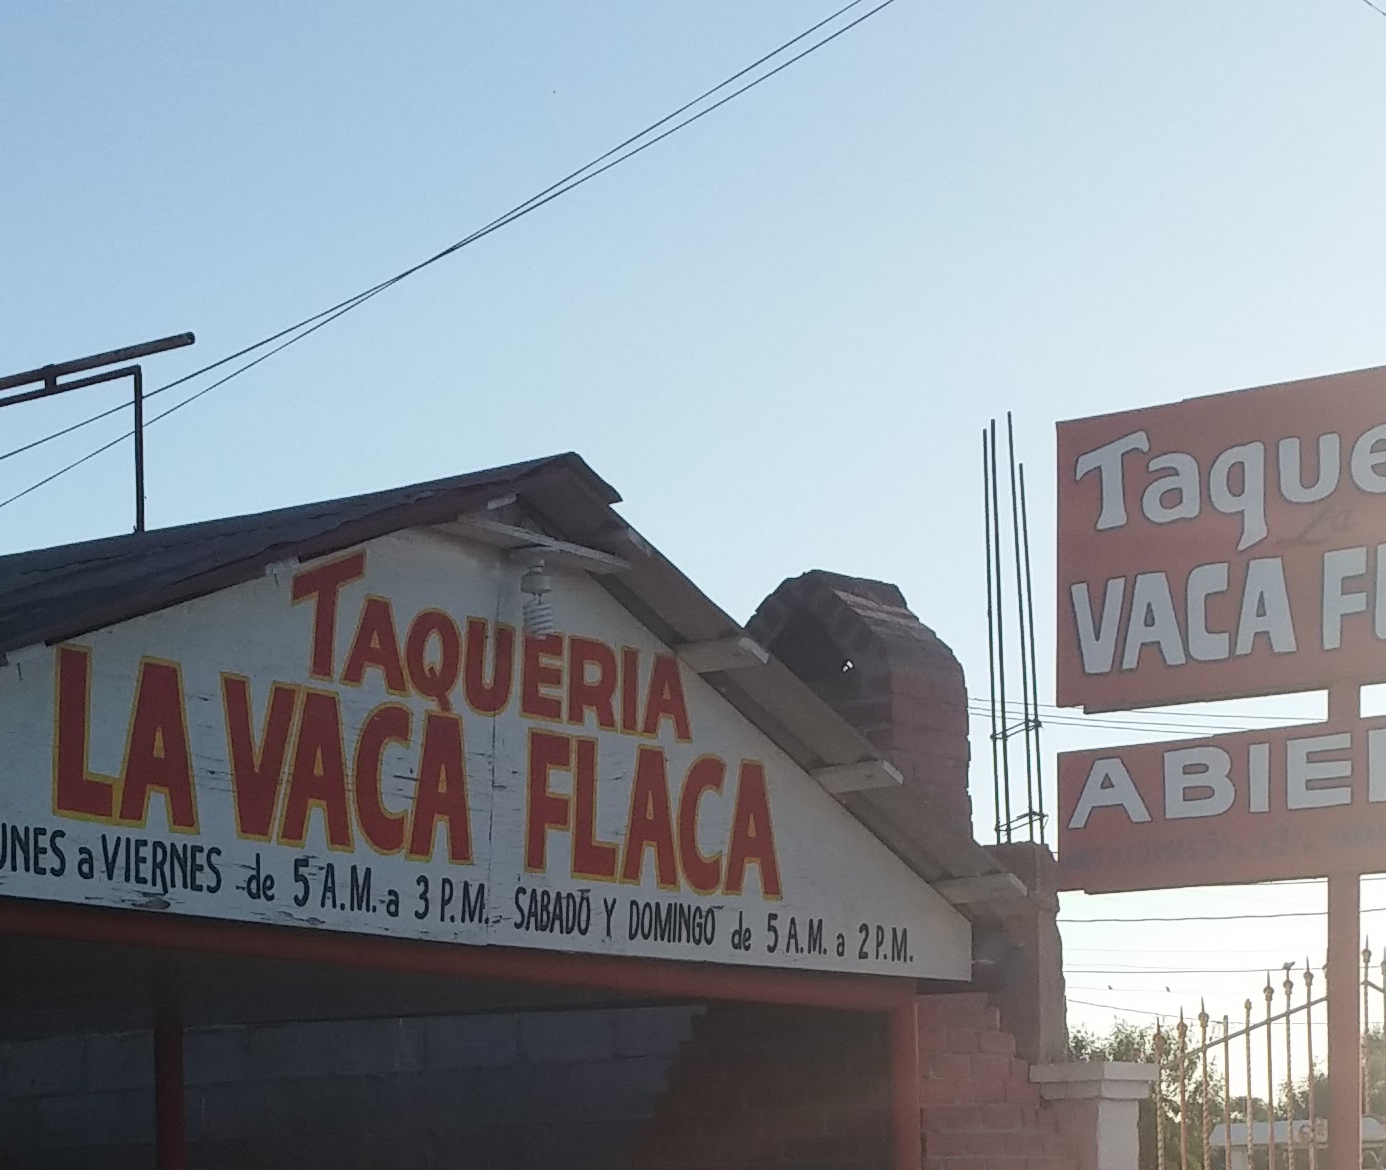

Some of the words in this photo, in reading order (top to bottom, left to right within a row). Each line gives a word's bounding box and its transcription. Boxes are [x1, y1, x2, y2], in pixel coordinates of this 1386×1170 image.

[291, 549, 692, 743] TAQUERIA
[1069, 556, 1298, 674] VACA
[52, 642, 200, 835] LA
[219, 671, 474, 865] VACA
[524, 727, 783, 900] FLACA
[78, 846, 95, 880] a
[101, 833, 222, 895] VIERNES
[246, 852, 275, 901] de
[293, 857, 310, 907] 5
[414, 874, 430, 920] 3
[603, 897, 616, 940] Y
[731, 910, 752, 952] de
[766, 912, 779, 954] 5
[785, 916, 827, 959] A.M.
[836, 939, 846, 959] a
[858, 923, 870, 961] 2
[874, 925, 913, 963] P.M.
